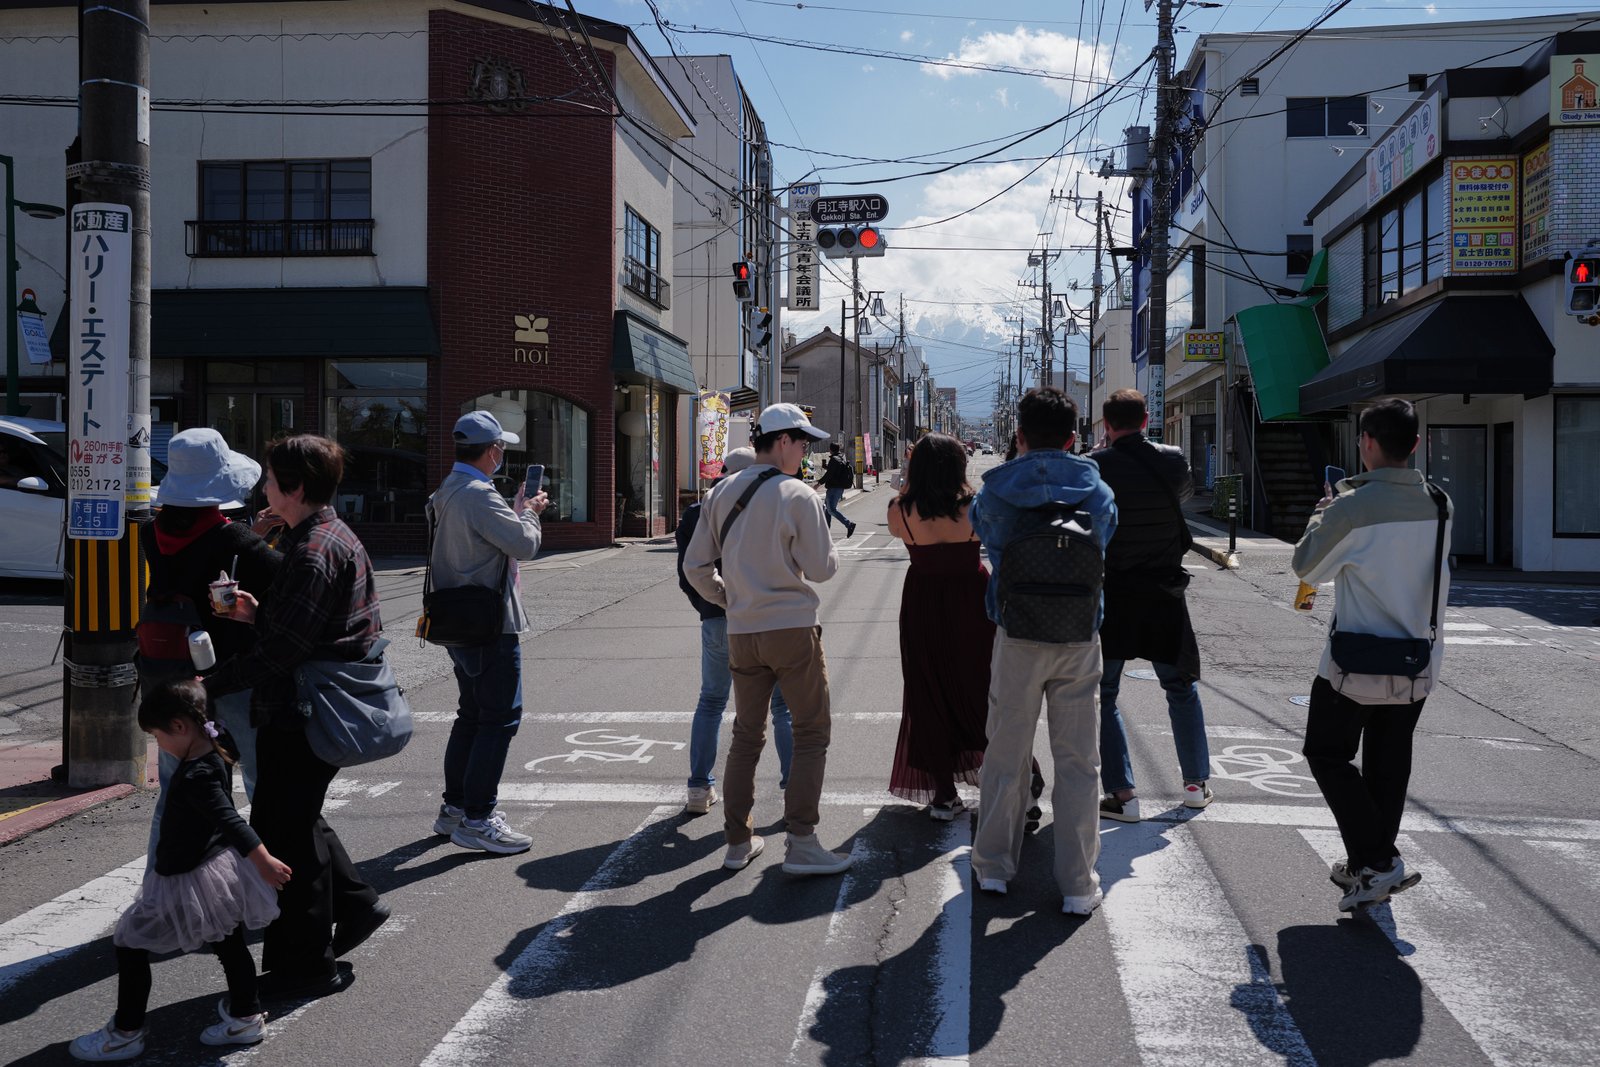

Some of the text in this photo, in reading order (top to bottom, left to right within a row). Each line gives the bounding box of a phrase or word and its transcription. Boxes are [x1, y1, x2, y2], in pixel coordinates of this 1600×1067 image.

[1562, 113, 1582, 121] Study
[1457, 165, 1513, 179] 生徒募集
[817, 199, 881, 214] 月江寺駅入口
[75, 211, 124, 231] 不動産
[821, 211, 878, 221] Gekkoji Sta. Ent.
[1455, 233, 1513, 246] 学習空間
[1458, 248, 1511, 257] 富士吉田教室
[80, 234, 110, 437] ハリー・エステート
[514, 345, 549, 365] noi
[1154, 380, 1163, 418] よねやま
[83, 441, 123, 453] 260m手前
[83, 453, 123, 465] 曲がる
[70, 466, 91, 478] 0555
[74, 502, 108, 514] 下吉田
[77, 516, 102, 528] 2-5
